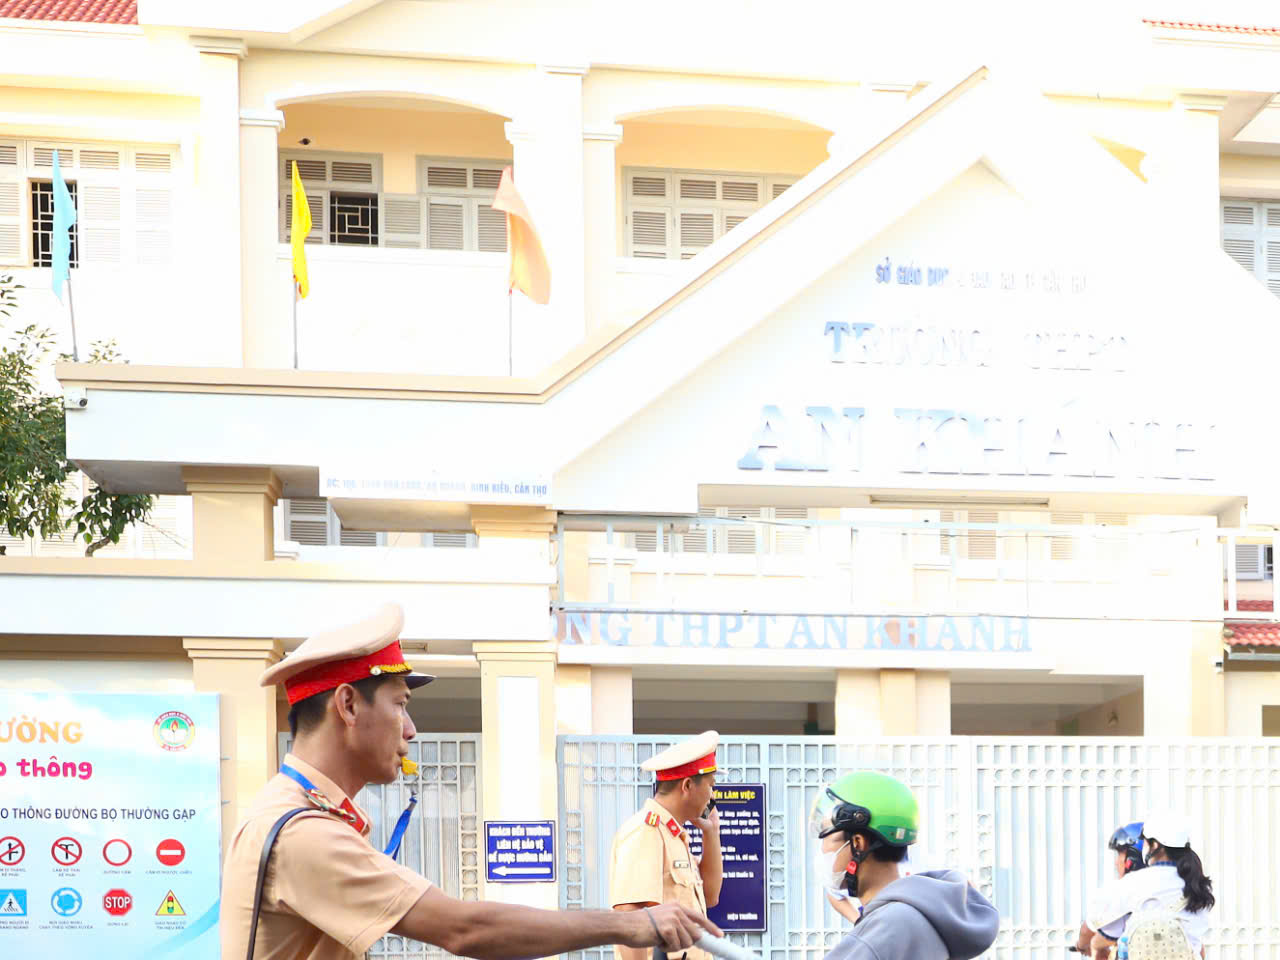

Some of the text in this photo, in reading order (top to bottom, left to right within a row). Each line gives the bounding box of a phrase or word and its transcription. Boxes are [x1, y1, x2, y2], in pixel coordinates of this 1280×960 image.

[644, 613, 778, 649] THPT
[783, 614, 850, 651] AN
[16, 755, 93, 780] thông
[13, 805, 51, 820] THÔNG
[55, 806, 98, 820] ĐƯỜNG
[121, 805, 169, 820] THƯỜNG
[105, 896, 131, 909] STOP
